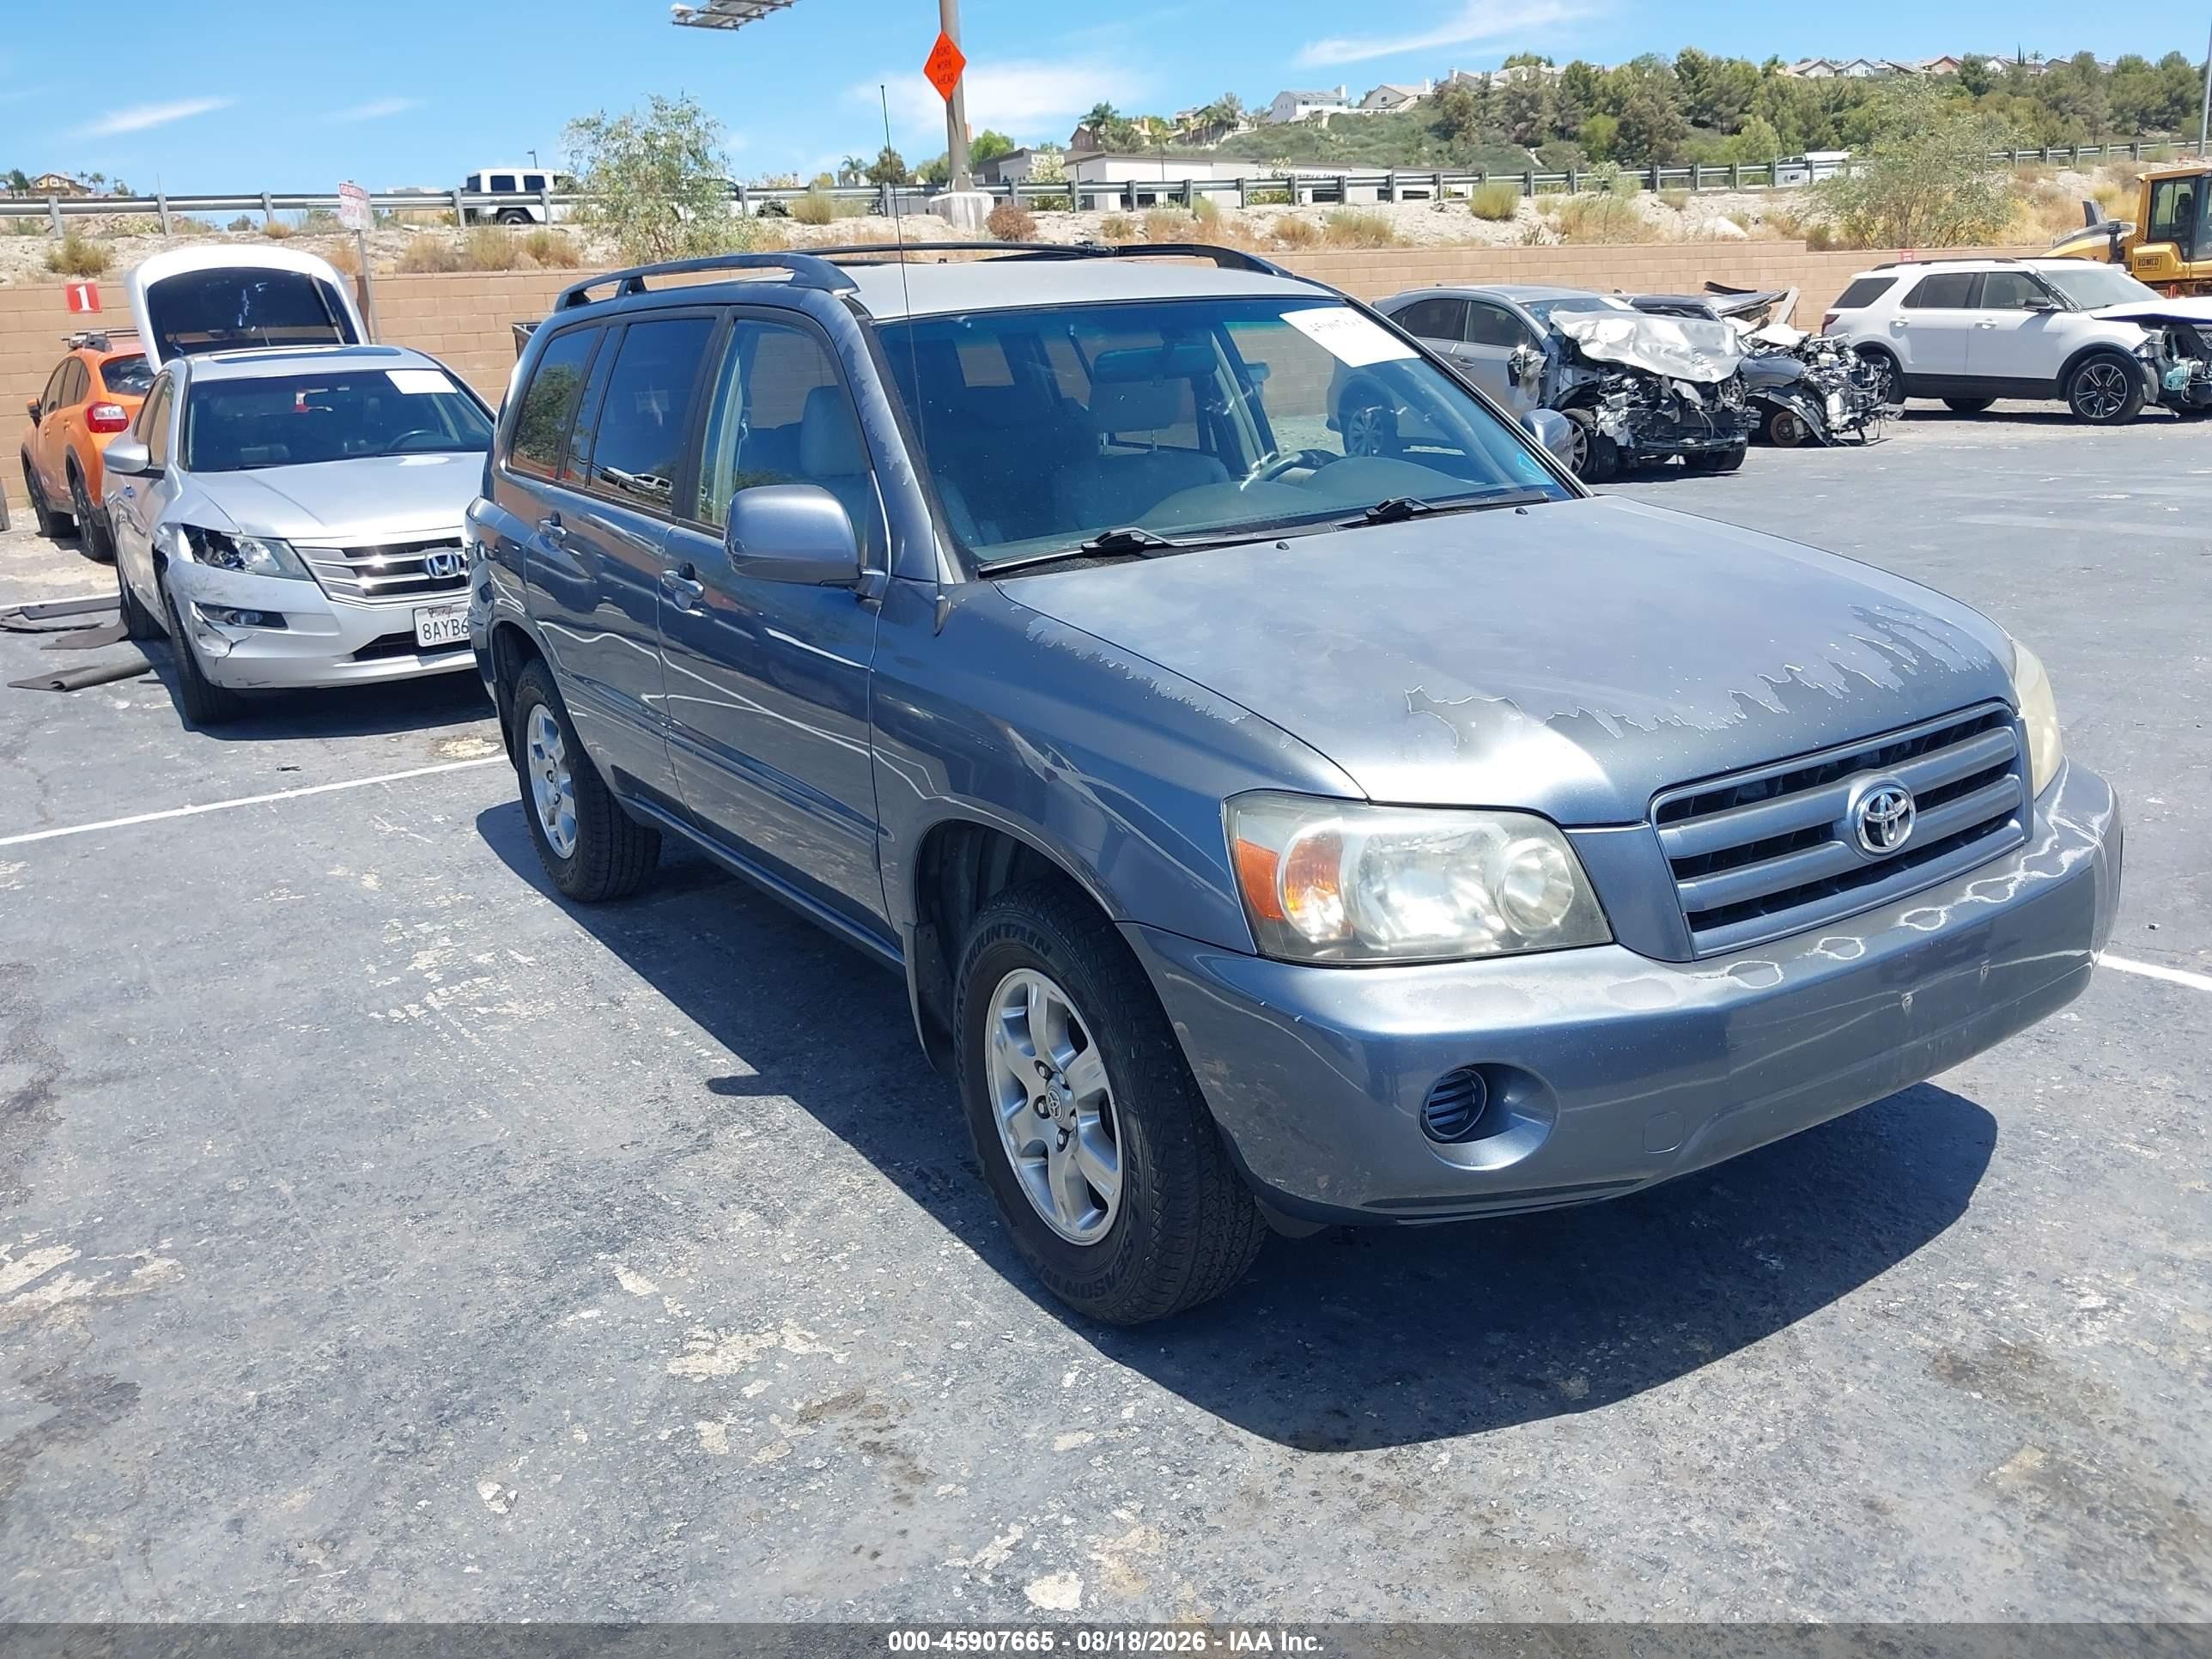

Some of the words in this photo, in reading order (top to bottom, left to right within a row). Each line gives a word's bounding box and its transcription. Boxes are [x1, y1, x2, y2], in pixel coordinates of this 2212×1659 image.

[937, 45, 951, 56] ROAD
[76, 285, 94, 311] 1
[422, 617, 469, 640] 8AYB6
